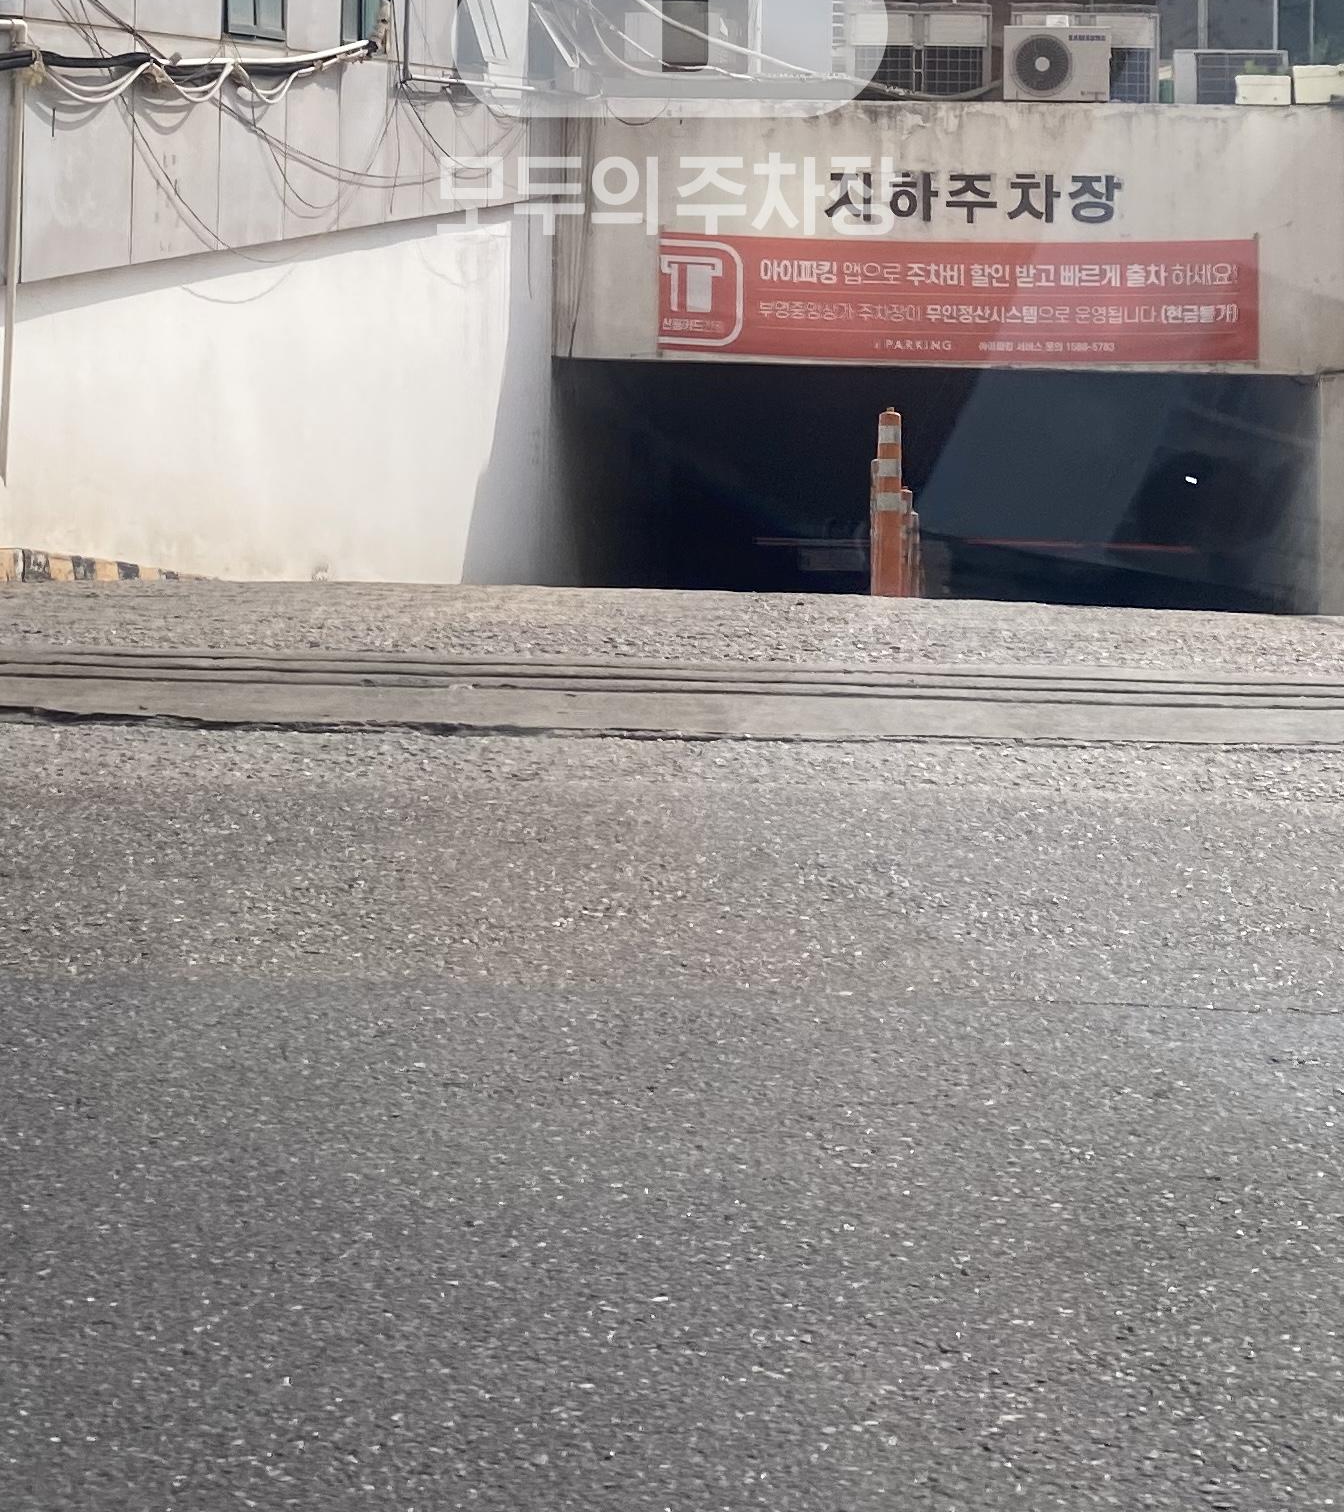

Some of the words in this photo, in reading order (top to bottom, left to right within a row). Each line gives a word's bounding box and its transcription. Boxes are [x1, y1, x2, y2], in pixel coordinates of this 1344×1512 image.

[824, 172, 1123, 224] 지하주차장
[759, 259, 837, 284] 아이파킹
[843, 261, 902, 285] 앱으로
[907, 263, 964, 286] 주차비
[970, 264, 1010, 287] 할인
[1016, 264, 1056, 287] 받고
[1060, 264, 1120, 287] 빠르게
[1126, 264, 1168, 287] 출차
[886, 339, 952, 352] PARKING
